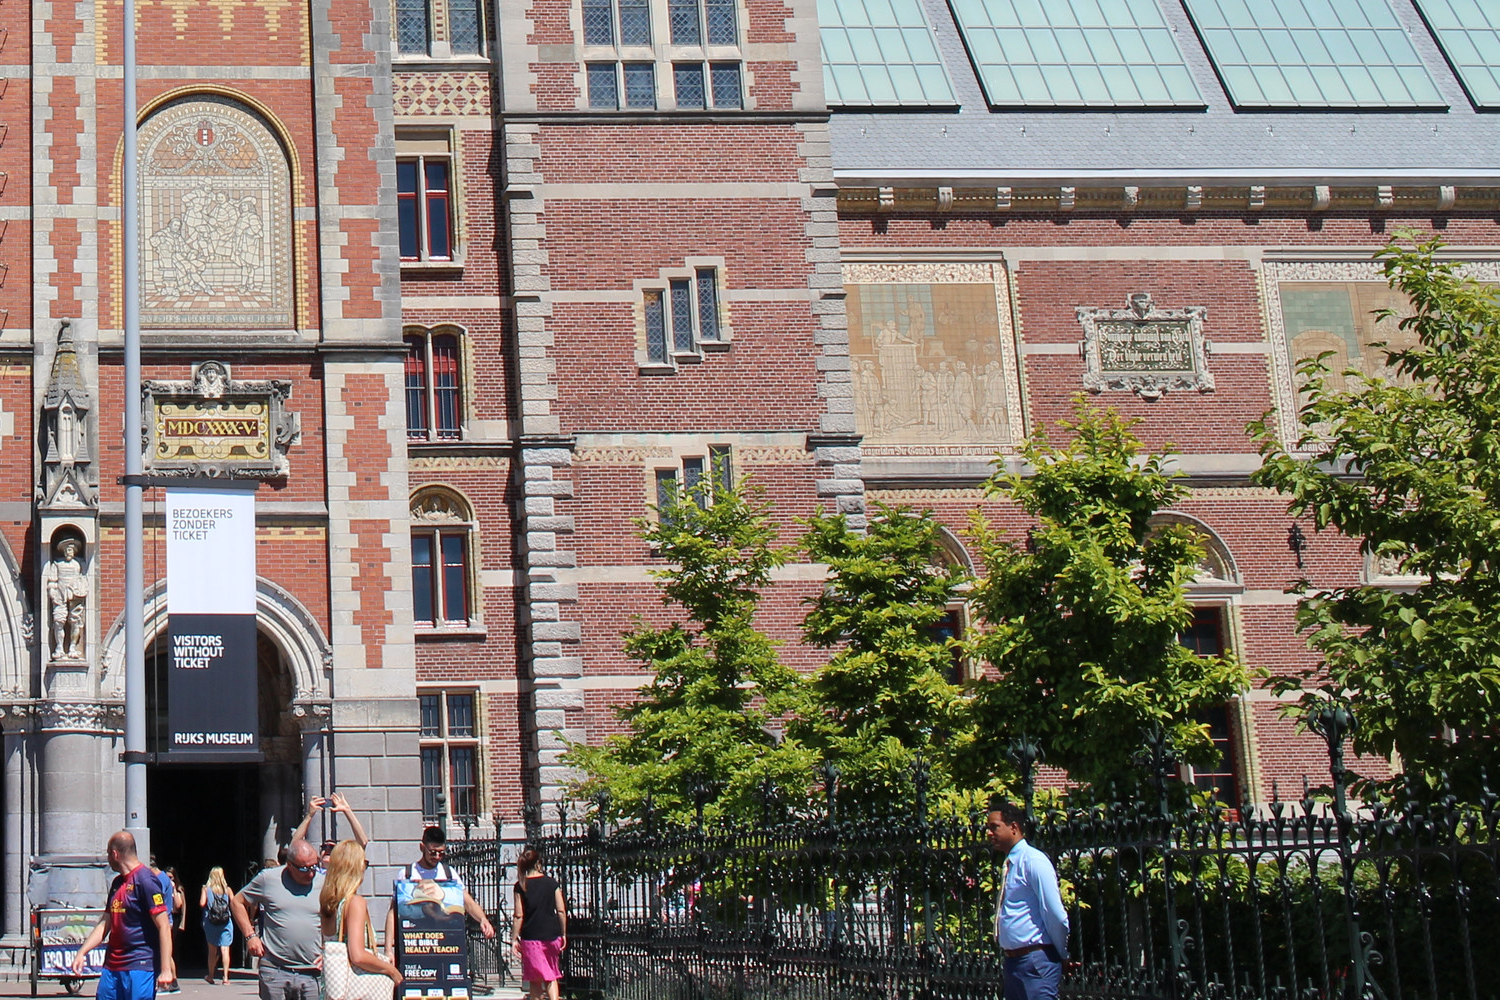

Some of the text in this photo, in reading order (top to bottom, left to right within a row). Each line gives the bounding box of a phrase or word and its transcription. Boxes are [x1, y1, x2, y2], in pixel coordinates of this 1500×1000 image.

[172, 508, 233, 519] BEZOEKERS
[172, 519, 216, 530] ZONDER
[172, 530, 208, 541] TICKET
[173, 635, 222, 646] VISITORS
[173, 646, 225, 658] WITHOUT
[173, 657, 211, 669] TICKET
[174, 732, 253, 744] RIJKS MUSEUM
[404, 969, 420, 977] FREE
[420, 969, 437, 977] COPY
